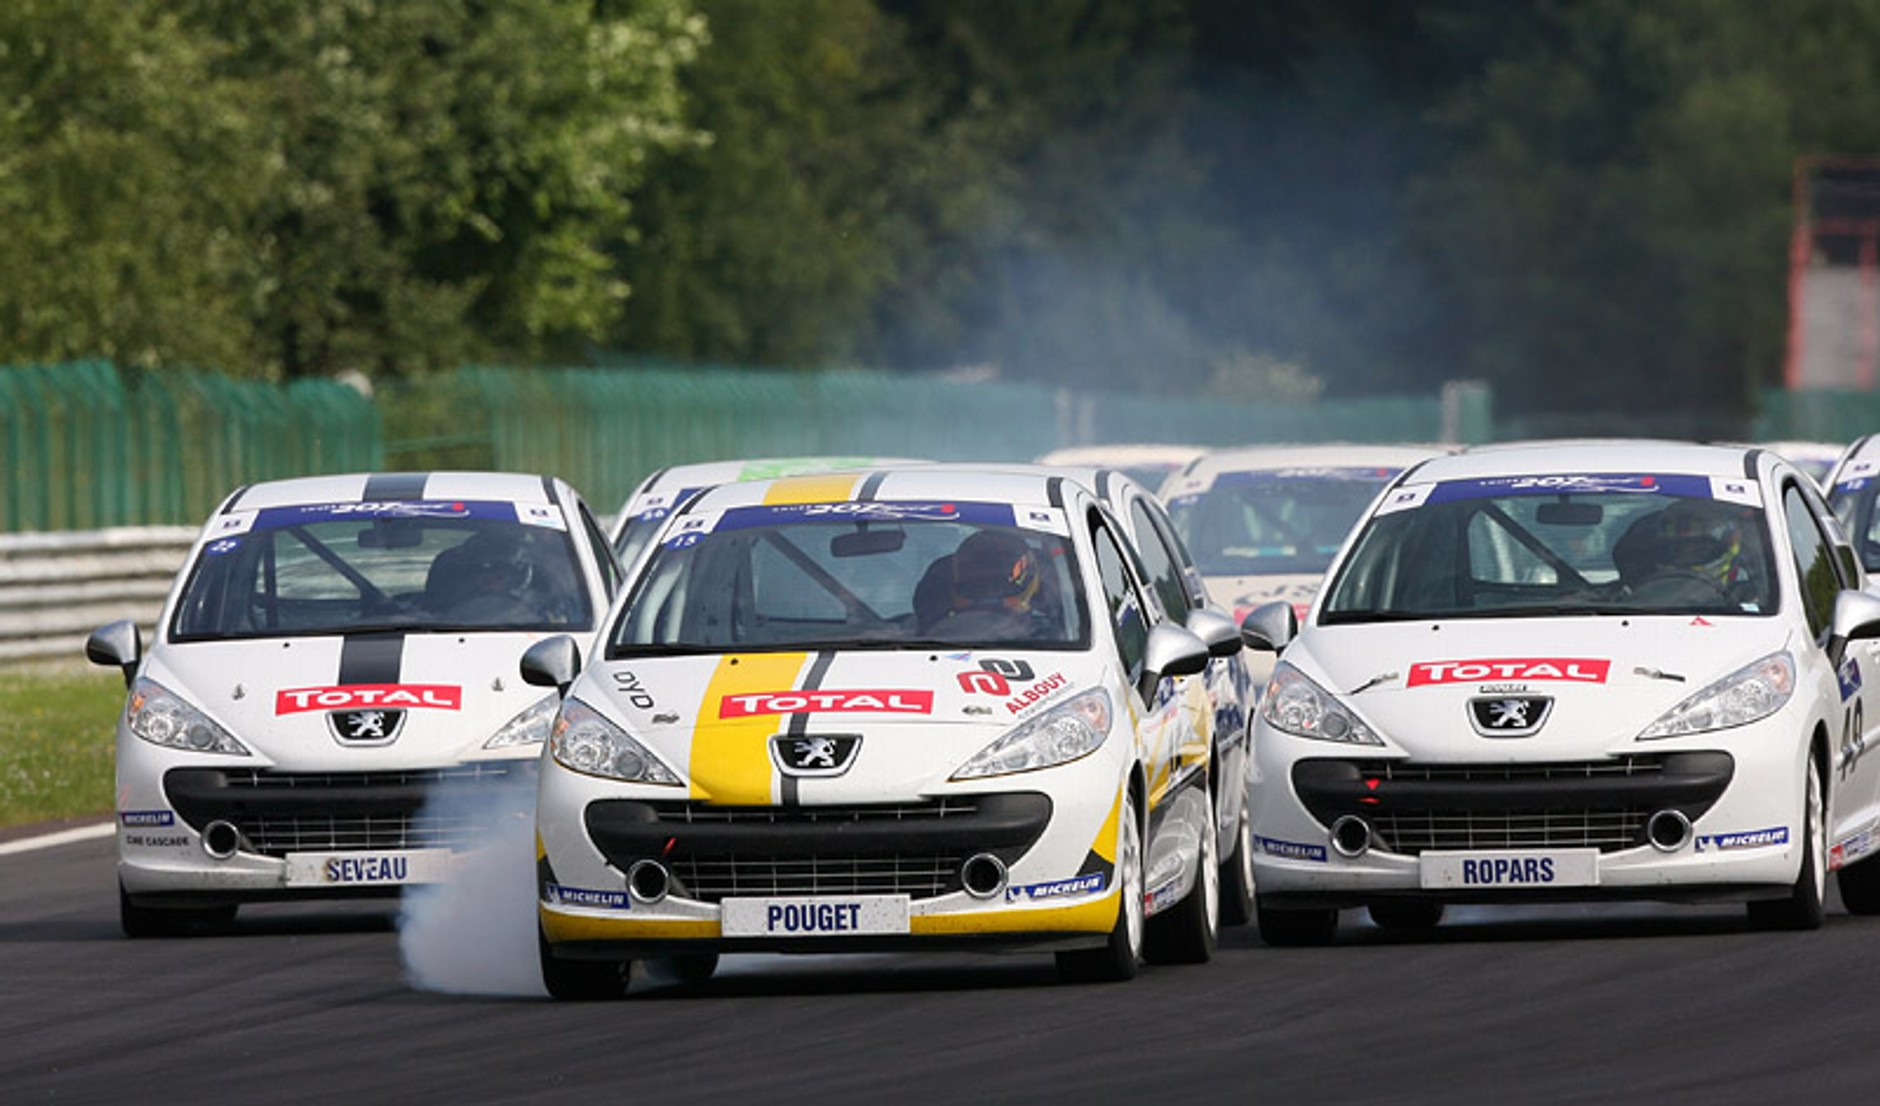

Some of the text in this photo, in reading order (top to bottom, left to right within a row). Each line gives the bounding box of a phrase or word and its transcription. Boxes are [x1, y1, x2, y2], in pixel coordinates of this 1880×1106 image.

[674, 534, 697, 548] 15
[1419, 663, 1598, 681] TOTAL
[284, 689, 453, 708] TOTAL
[613, 671, 655, 709] DYD
[1005, 672, 1067, 715] ALBOUY
[731, 694, 923, 713] TOTAL
[1720, 830, 1786, 847] MICHELIN
[325, 857, 407, 882] SEVEAU
[1462, 857, 1555, 884] ROPARS
[1033, 877, 1100, 897] MICHELIN
[562, 889, 625, 905] MICHELIN
[767, 903, 861, 932] POUGET
